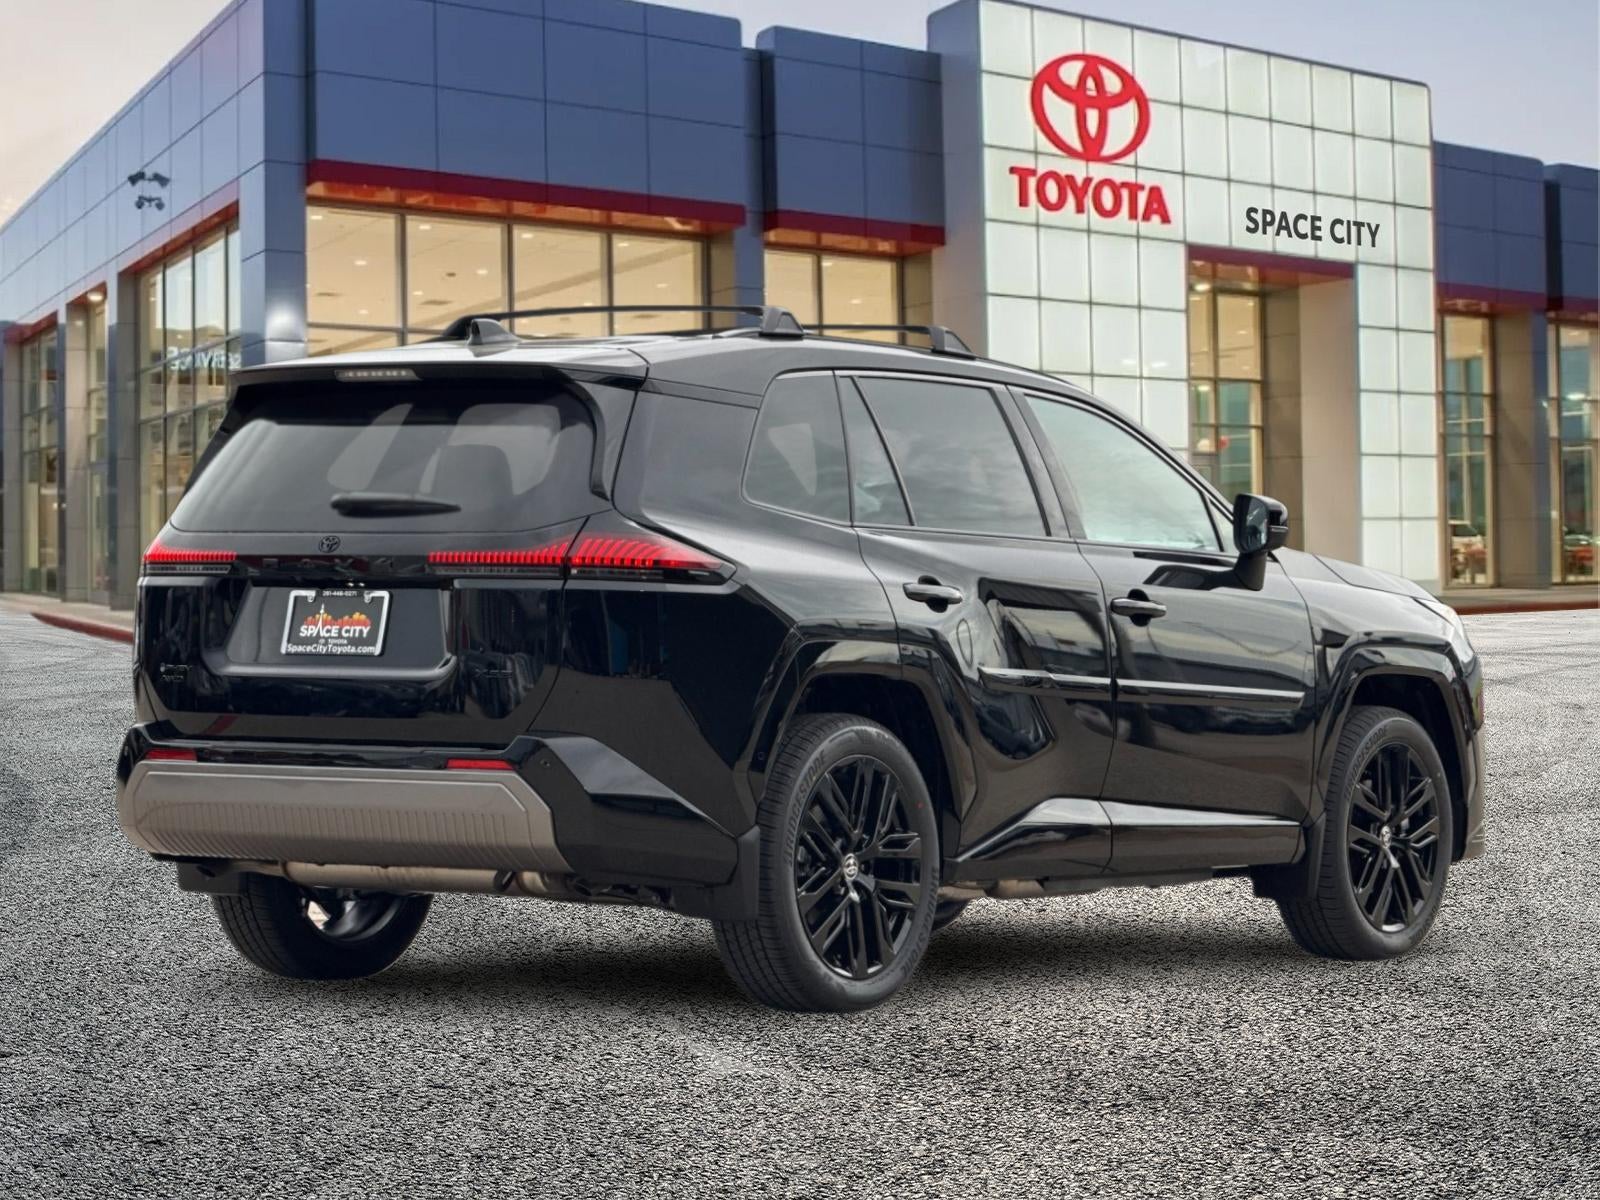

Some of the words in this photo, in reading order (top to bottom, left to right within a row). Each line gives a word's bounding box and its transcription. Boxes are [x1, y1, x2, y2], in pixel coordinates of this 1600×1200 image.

[1009, 166, 1171, 225] TOYOTA
[1245, 206, 1323, 242] SPACE
[1329, 217, 1381, 248] CITY
[299, 625, 339, 638] SPACE
[341, 625, 371, 637] CITY
[287, 643, 376, 653] SpaceCityToyota.com
